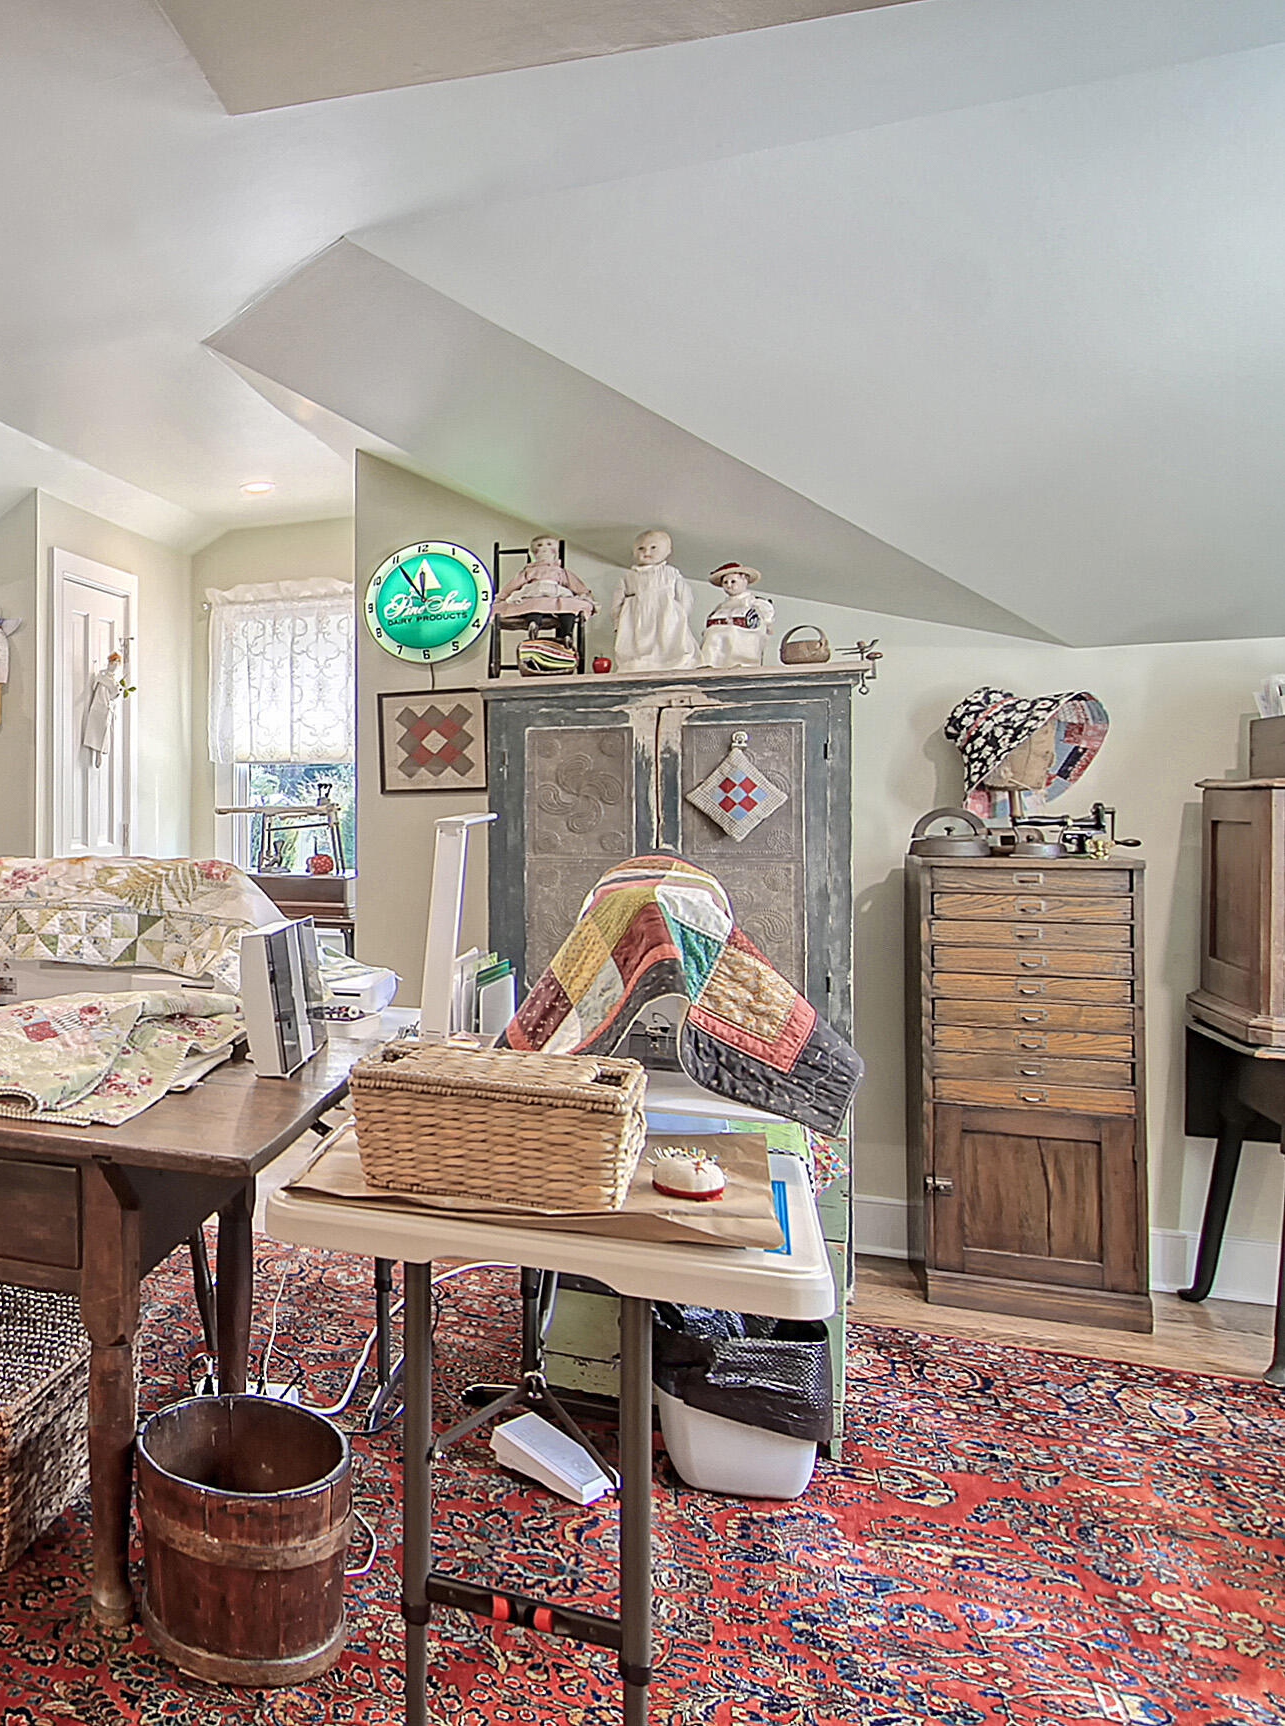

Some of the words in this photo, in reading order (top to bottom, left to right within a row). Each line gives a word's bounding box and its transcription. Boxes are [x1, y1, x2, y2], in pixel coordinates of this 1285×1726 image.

[417, 545, 429, 553] 12
[451, 547, 456, 555] 1
[393, 555, 400, 564] 11
[472, 564, 480, 573] 2
[373, 576, 381, 586] 10
[482, 591, 488, 601] 3
[368, 603, 373, 613] 9
[384, 594, 425, 619] Pine
[425, 590, 472, 613] State
[387, 618, 412, 626] DAIRY
[416, 612, 467, 622] PRODUCTS
[472, 618, 480, 629] 4
[376, 628, 382, 638] 8
[397, 645, 403, 655] 7
[452, 641, 459, 651] 5
[423, 650, 430, 659] 6
